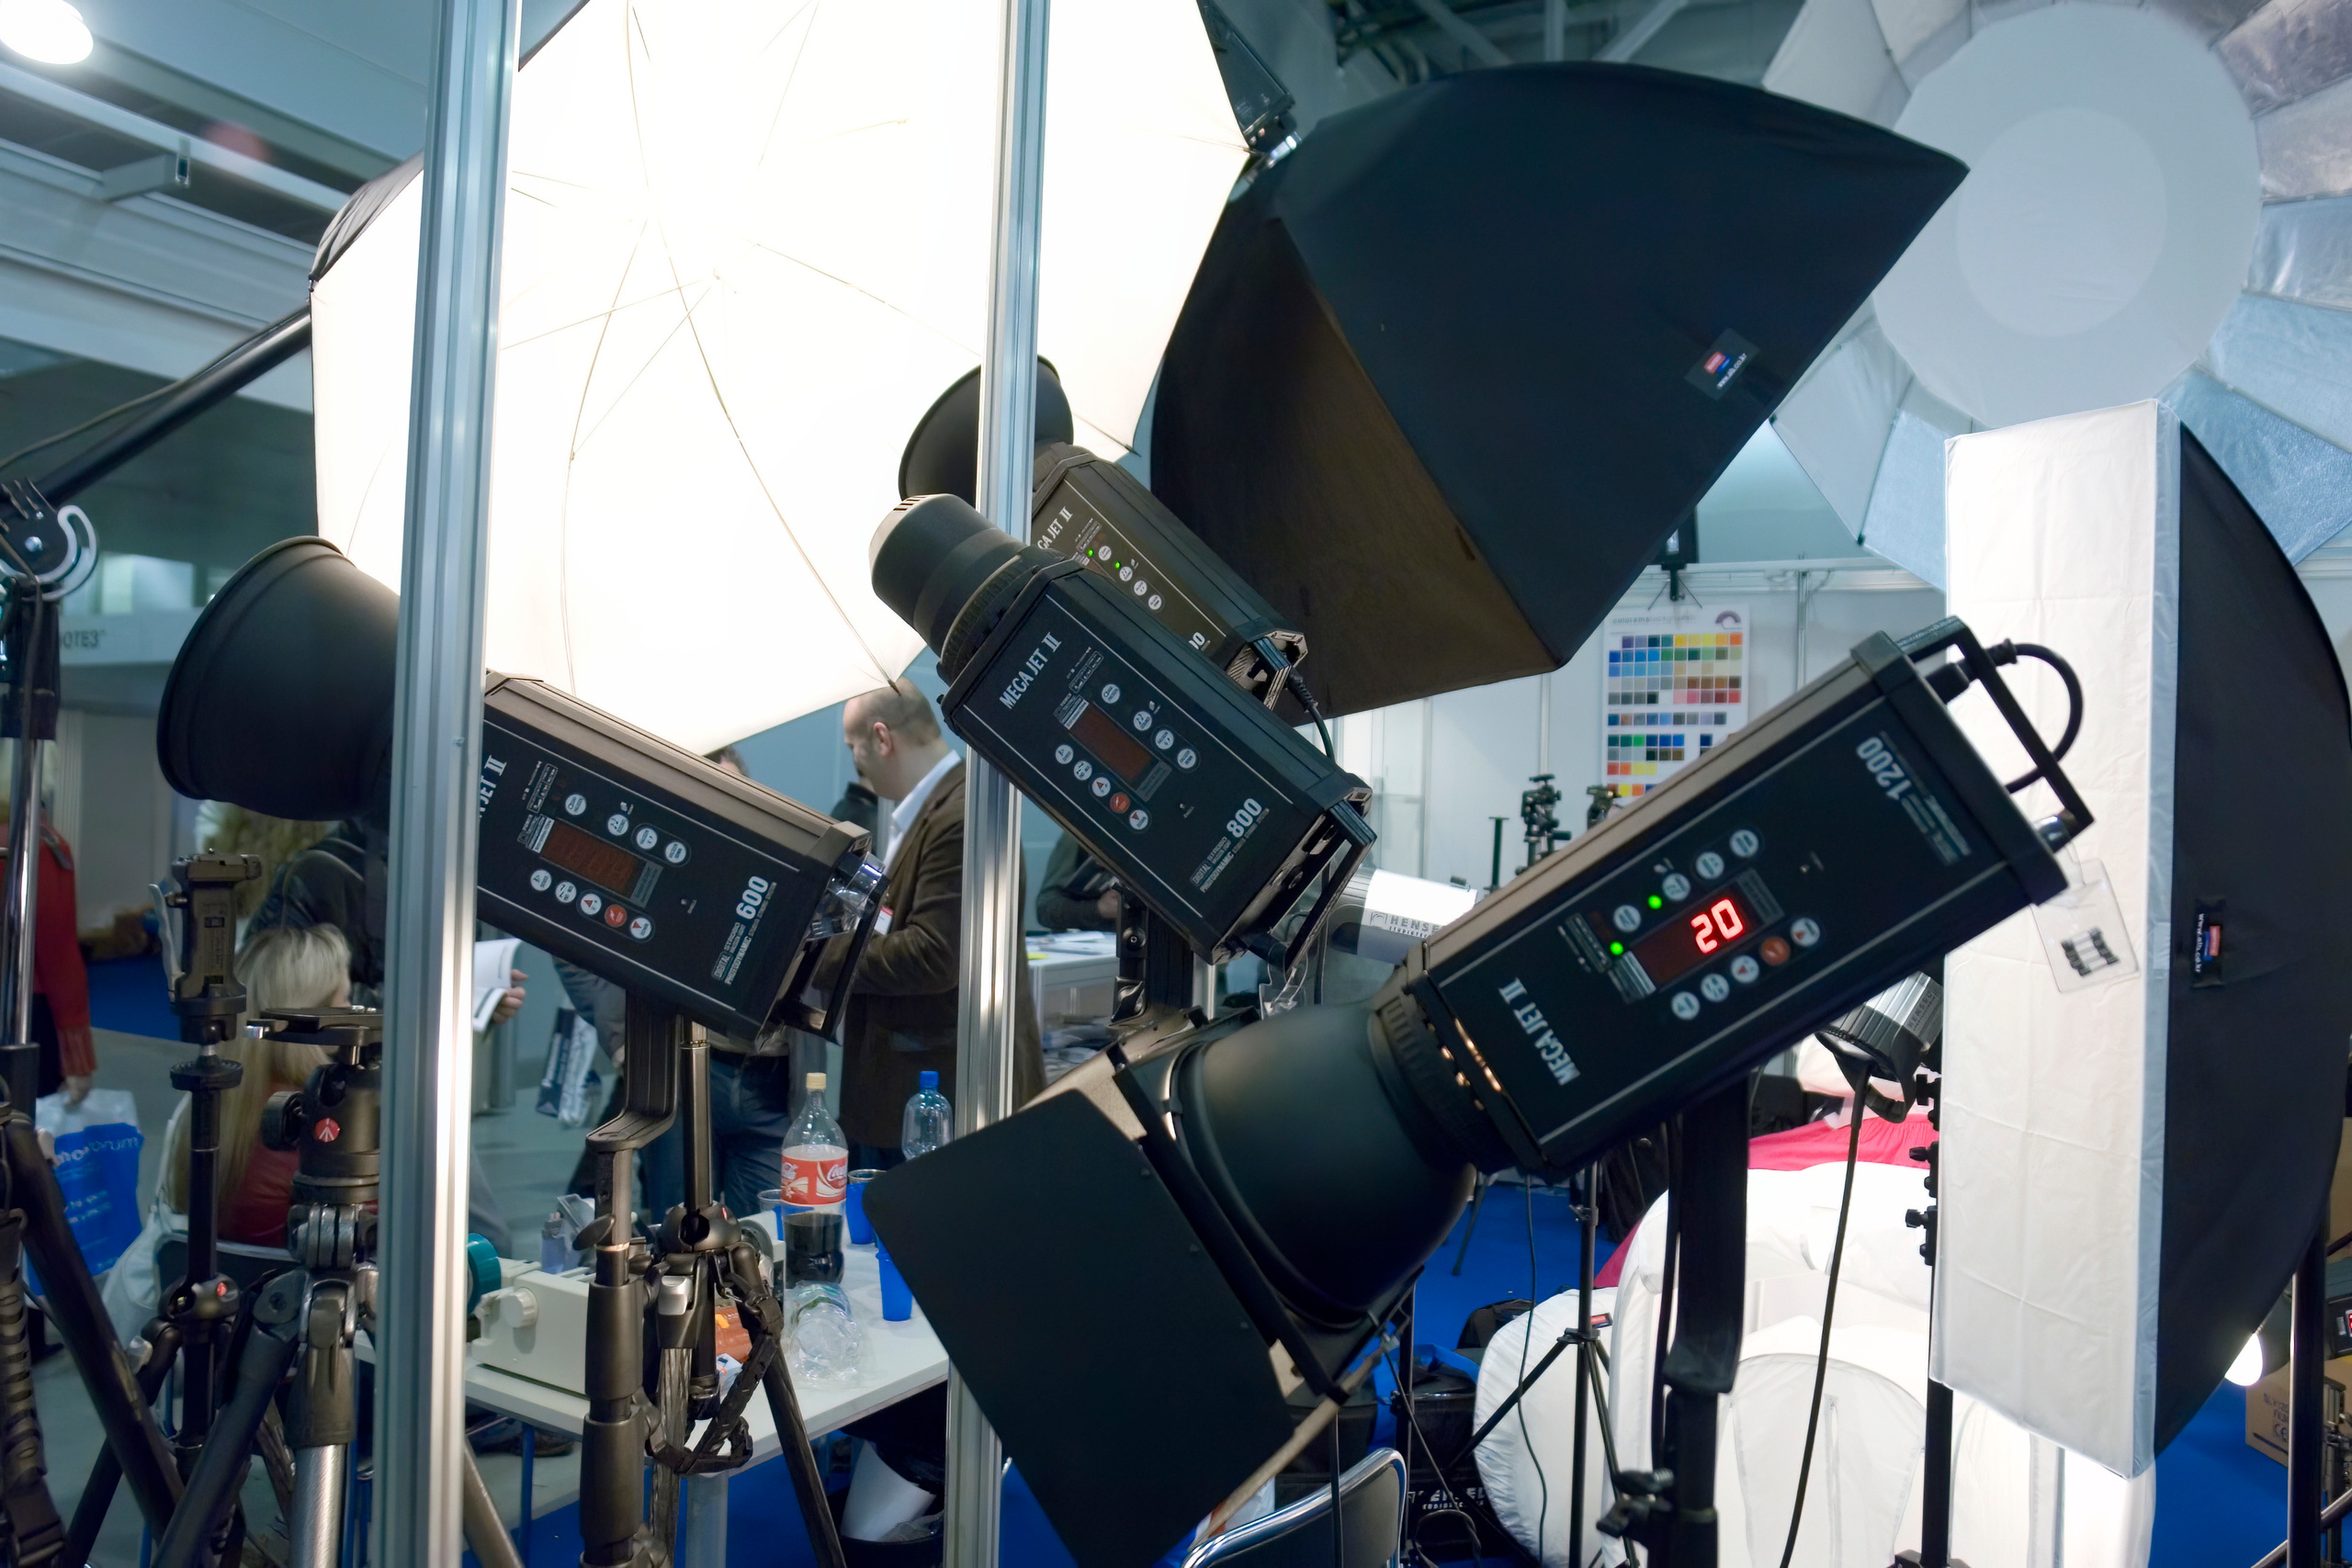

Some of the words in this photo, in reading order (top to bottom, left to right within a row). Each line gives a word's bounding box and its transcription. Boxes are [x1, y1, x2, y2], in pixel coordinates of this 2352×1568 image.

[1036, 534, 1053, 548] GA
[1046, 517, 1063, 538] JET
[999, 671, 1034, 709] MEGA
[1025, 648, 1048, 675] JET
[1041, 630, 1061, 653] II
[1854, 735, 1912, 799] 1200
[1226, 797, 1261, 838] 800
[736, 874, 768, 919] 600
[1388, 926, 1430, 938] STUDIOTEC
[1390, 916, 1441, 933] HENSE
[1497, 976, 1528, 1004] II
[1511, 1000, 1549, 1035] JET
[1532, 1027, 1581, 1086] MEGA
